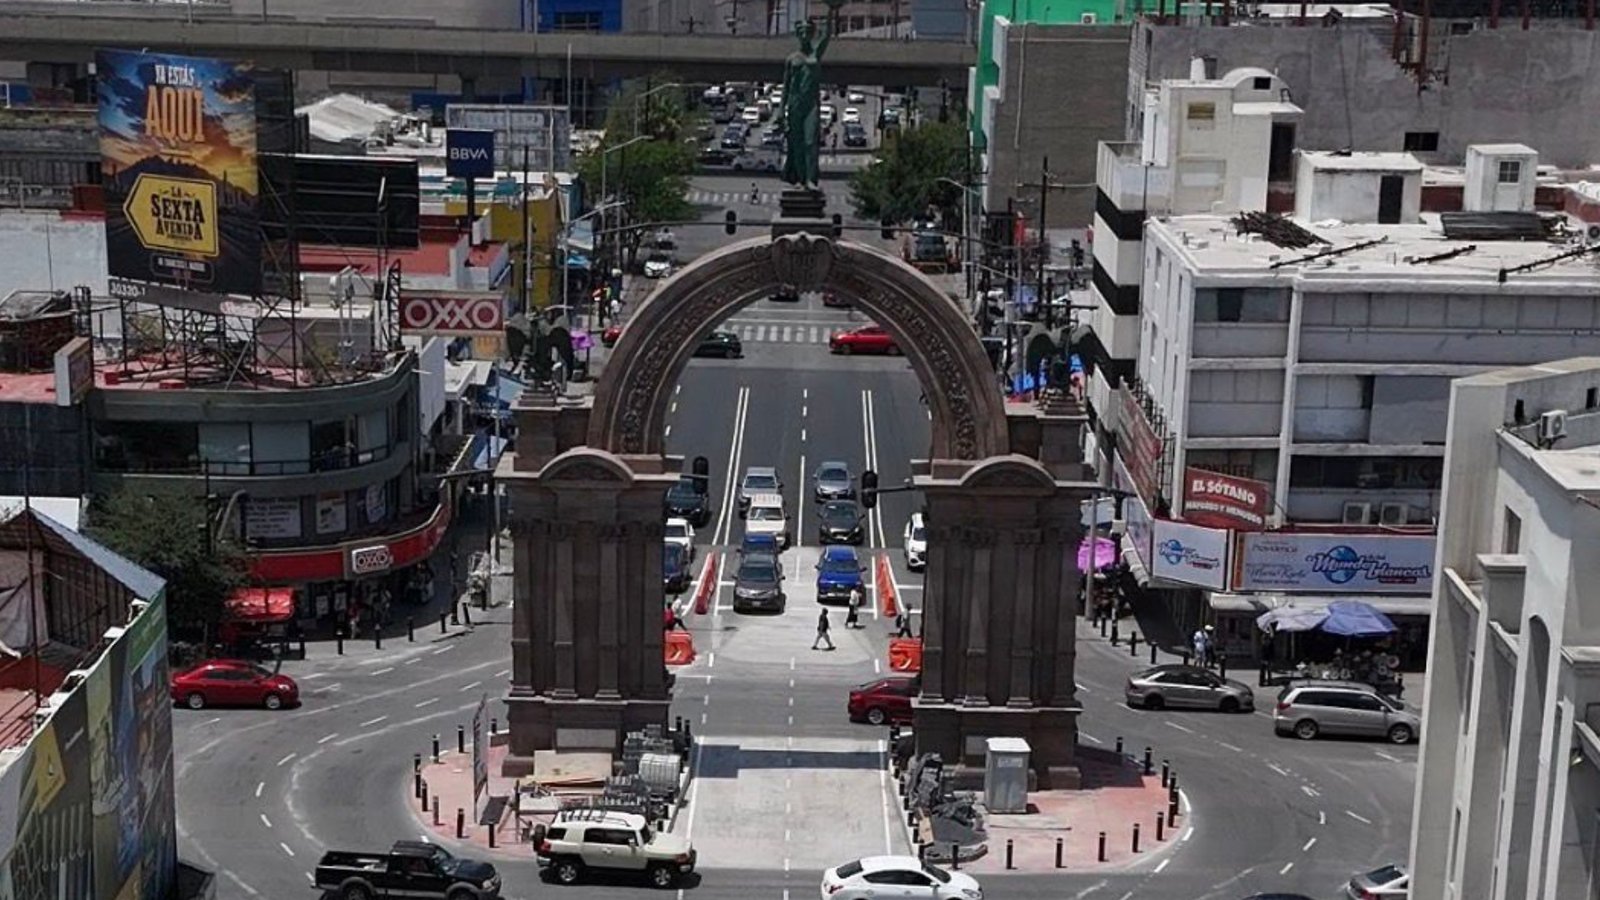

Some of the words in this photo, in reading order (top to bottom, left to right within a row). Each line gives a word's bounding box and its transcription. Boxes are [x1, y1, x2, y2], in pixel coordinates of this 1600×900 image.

[155, 65, 166, 84] YA
[168, 64, 195, 86] ESTÁS
[450, 147, 489, 160] BBVA
[171, 186, 182, 198] LA
[151, 193, 205, 224] SEXTA
[156, 219, 203, 241] AVENIDA
[405, 299, 500, 329] OXXO
[1192, 480, 1206, 493] EL
[1206, 479, 1257, 505] SÓTANO
[357, 551, 388, 570] OXXO
[1312, 553, 1374, 573] Mundo
